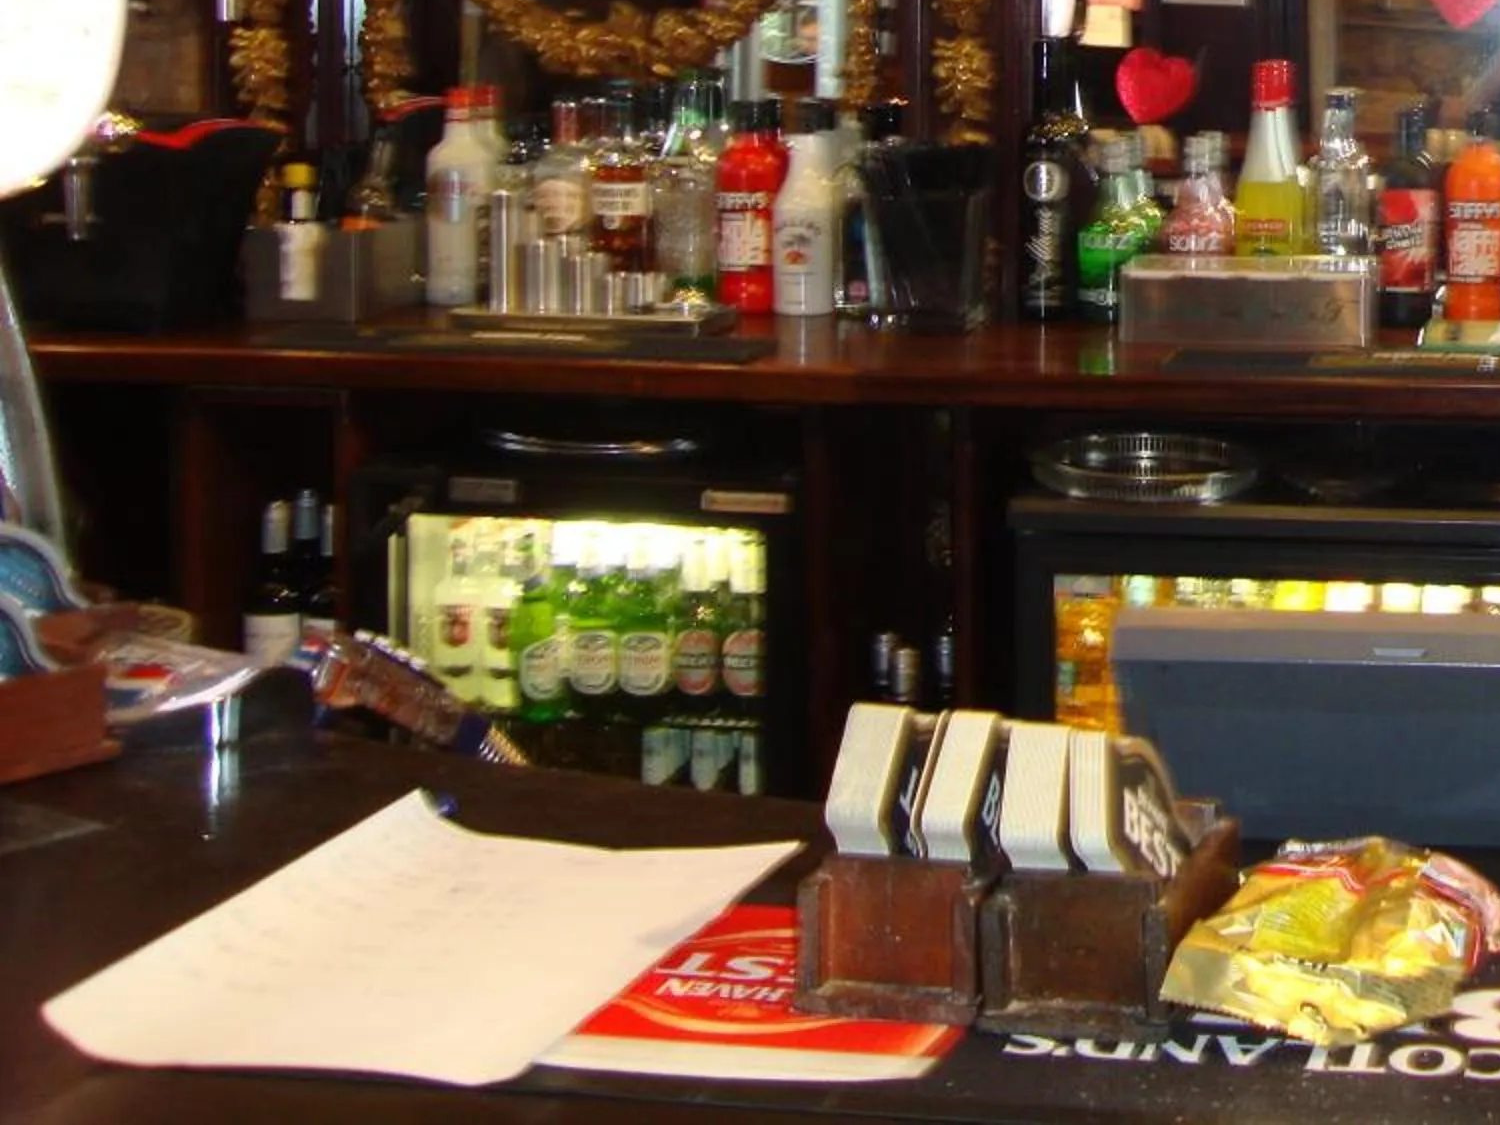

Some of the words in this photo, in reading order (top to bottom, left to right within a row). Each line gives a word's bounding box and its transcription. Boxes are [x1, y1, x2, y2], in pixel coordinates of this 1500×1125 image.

[1123, 786, 1184, 879] BEST
[655, 952, 796, 984] ST
[654, 976, 787, 1002] HAVEN
